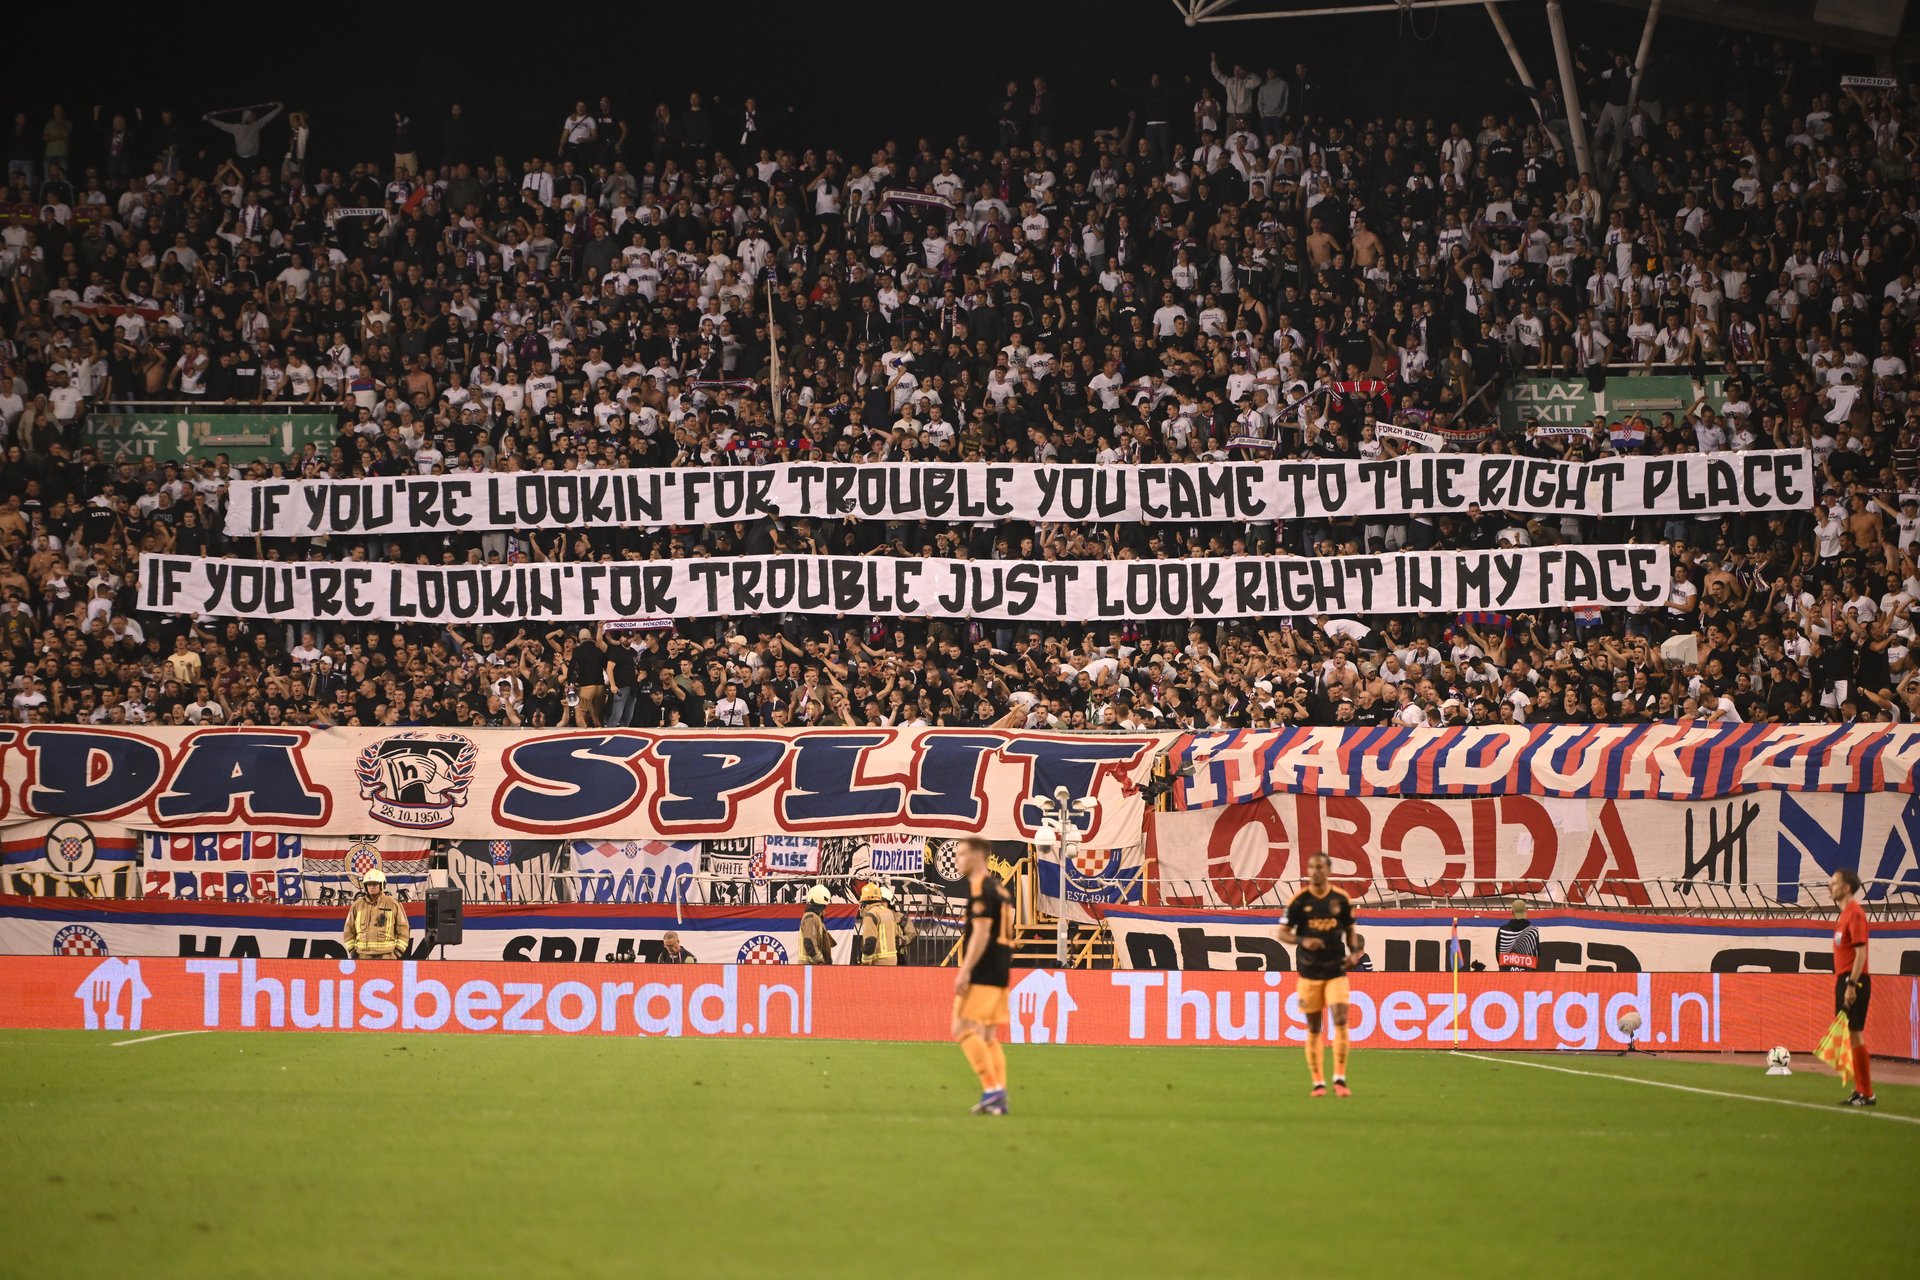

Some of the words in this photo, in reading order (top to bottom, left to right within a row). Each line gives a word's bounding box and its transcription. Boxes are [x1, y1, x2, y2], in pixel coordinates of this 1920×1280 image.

[1517, 405, 1576, 421] EXIT
[97, 439, 158, 456] EXIT
[251, 485, 289, 532] IF
[304, 480, 472, 532] YOU'RE
[788, 467, 1013, 517] TROUBLE
[1034, 468, 1126, 519] YOU
[1138, 467, 1266, 519] CAME
[1279, 464, 1346, 517] TO
[1358, 459, 1465, 509] THE
[1479, 460, 1624, 513] RIGHT
[1643, 454, 1803, 510] PLACE
[148, 559, 191, 606] IF
[204, 563, 374, 616] YOU'RE
[689, 559, 922, 613] TROUBLE
[939, 564, 1078, 615] JUST
[1097, 563, 1222, 616] LOOK
[1236, 558, 1382, 612] RIGHT
[1395, 556, 1441, 607] IN
[1456, 554, 1522, 609] MY
[1539, 549, 1661, 604] FACE
[1186, 725, 1722, 805] HAJDUK
[494, 732, 1158, 834] SPLIT
[144, 832, 302, 861] TORCIDA
[771, 852, 808, 867] MIŠE
[144, 868, 303, 905] ZAGREB
[56, 926, 101, 943] HAJDUK
[740, 937, 785, 954] HAJDUK
[1503, 955, 1532, 966] PHOTO
[185, 957, 812, 1037] Thuisbezorgd.nl
[1111, 970, 1721, 1049] Thuisbezorgd.nl
